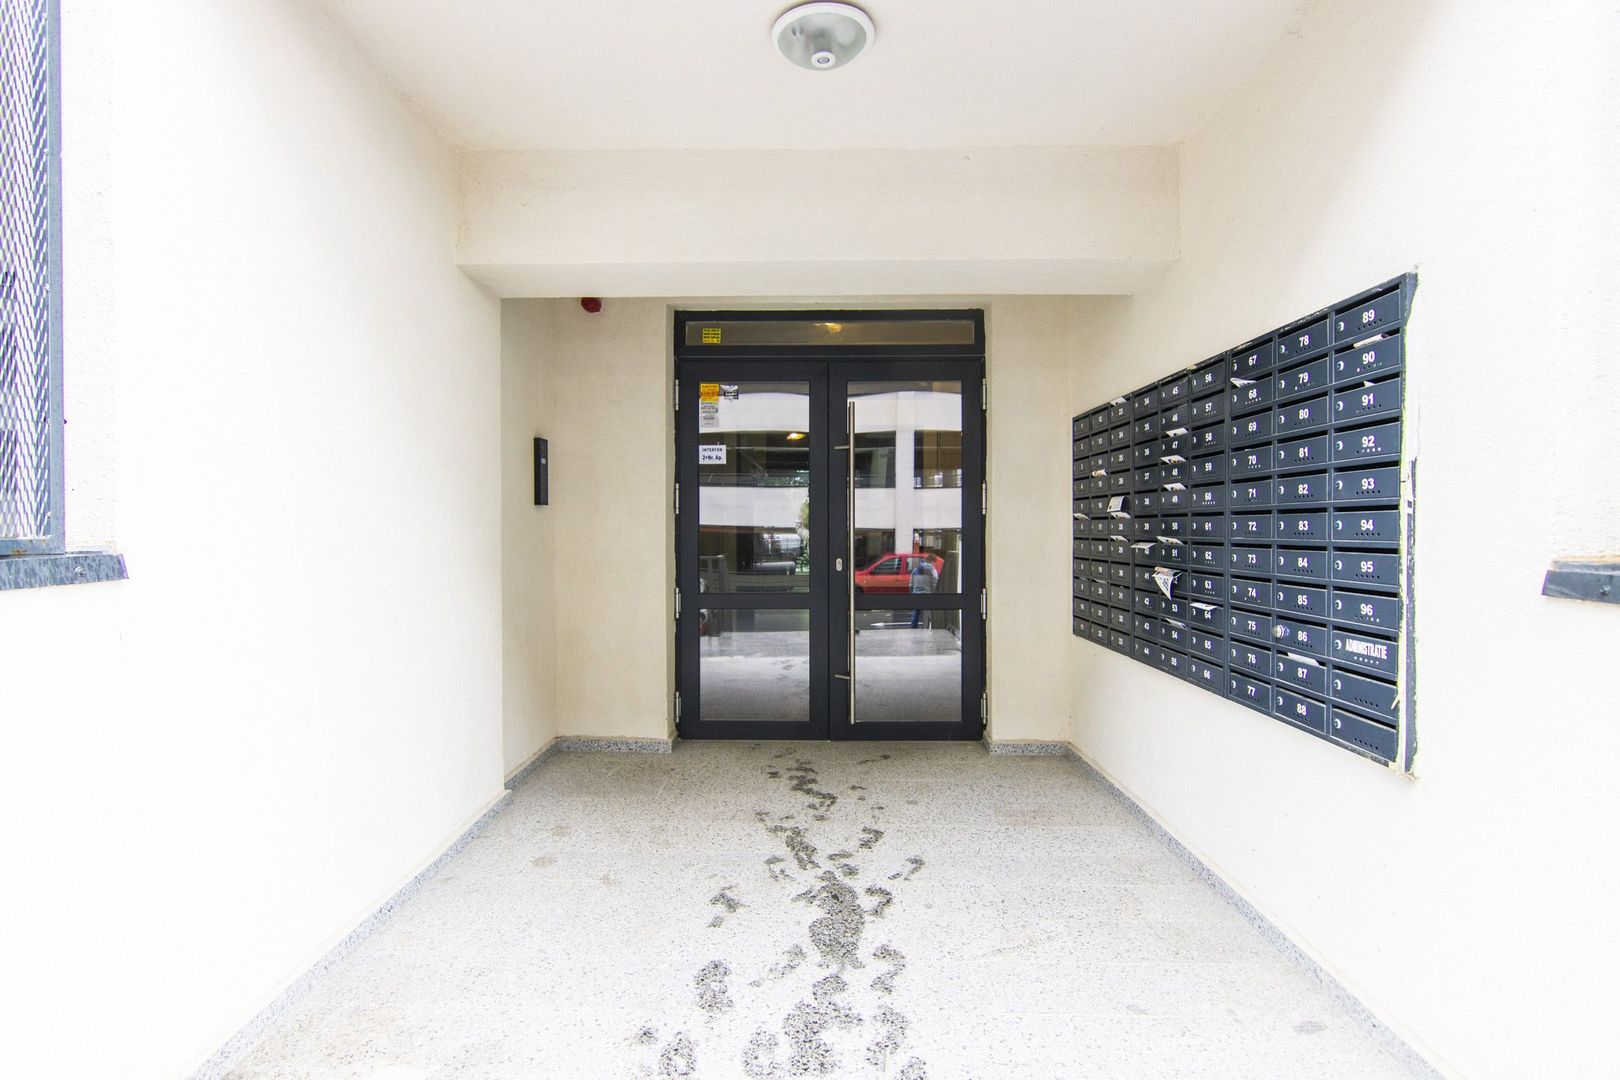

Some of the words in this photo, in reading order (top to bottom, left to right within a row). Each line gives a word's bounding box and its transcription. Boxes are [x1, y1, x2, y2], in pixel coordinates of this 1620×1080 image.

[1362, 309, 1375, 323] 89
[1299, 335, 1309, 347] 78
[1249, 355, 1257, 366] 67
[1362, 351, 1375, 364] 90
[1205, 373, 1212, 383] 56
[1299, 372, 1308, 384] 79
[1249, 389, 1257, 399] 68
[1362, 393, 1373, 406] 91
[1206, 403, 1212, 412] 57
[1299, 409, 1309, 419] 80
[1248, 422, 1256, 432] 69
[1206, 432, 1212, 441] 58
[1362, 435, 1375, 447] 92
[1299, 447, 1308, 457] 81
[1248, 455, 1256, 465] 70
[1205, 463, 1212, 471] 59
[1298, 484, 1308, 494] 82
[1362, 478, 1374, 490] 93
[1205, 492, 1211, 500] 60
[1248, 488, 1256, 497] 71
[1205, 522, 1211, 530] 61
[1248, 522, 1256, 530] 72
[1299, 521, 1308, 531] 83
[1361, 520, 1373, 531] 94
[1205, 551, 1212, 559] 62
[1248, 554, 1256, 563] 73
[1298, 557, 1308, 567] 84
[1361, 561, 1373, 572] 95
[1205, 580, 1211, 589] 63
[1248, 588, 1256, 597] 74
[1298, 595, 1307, 605] 85
[1204, 610, 1211, 619] 64
[1360, 604, 1373, 616] 96
[1248, 621, 1256, 630] 75
[1298, 631, 1307, 642] 86
[1205, 640, 1211, 649] 65
[1248, 653, 1256, 663] 76
[1204, 670, 1210, 679] 66
[1298, 668, 1307, 678] 87
[1247, 685, 1255, 696] 77
[1297, 703, 1306, 715] 88
